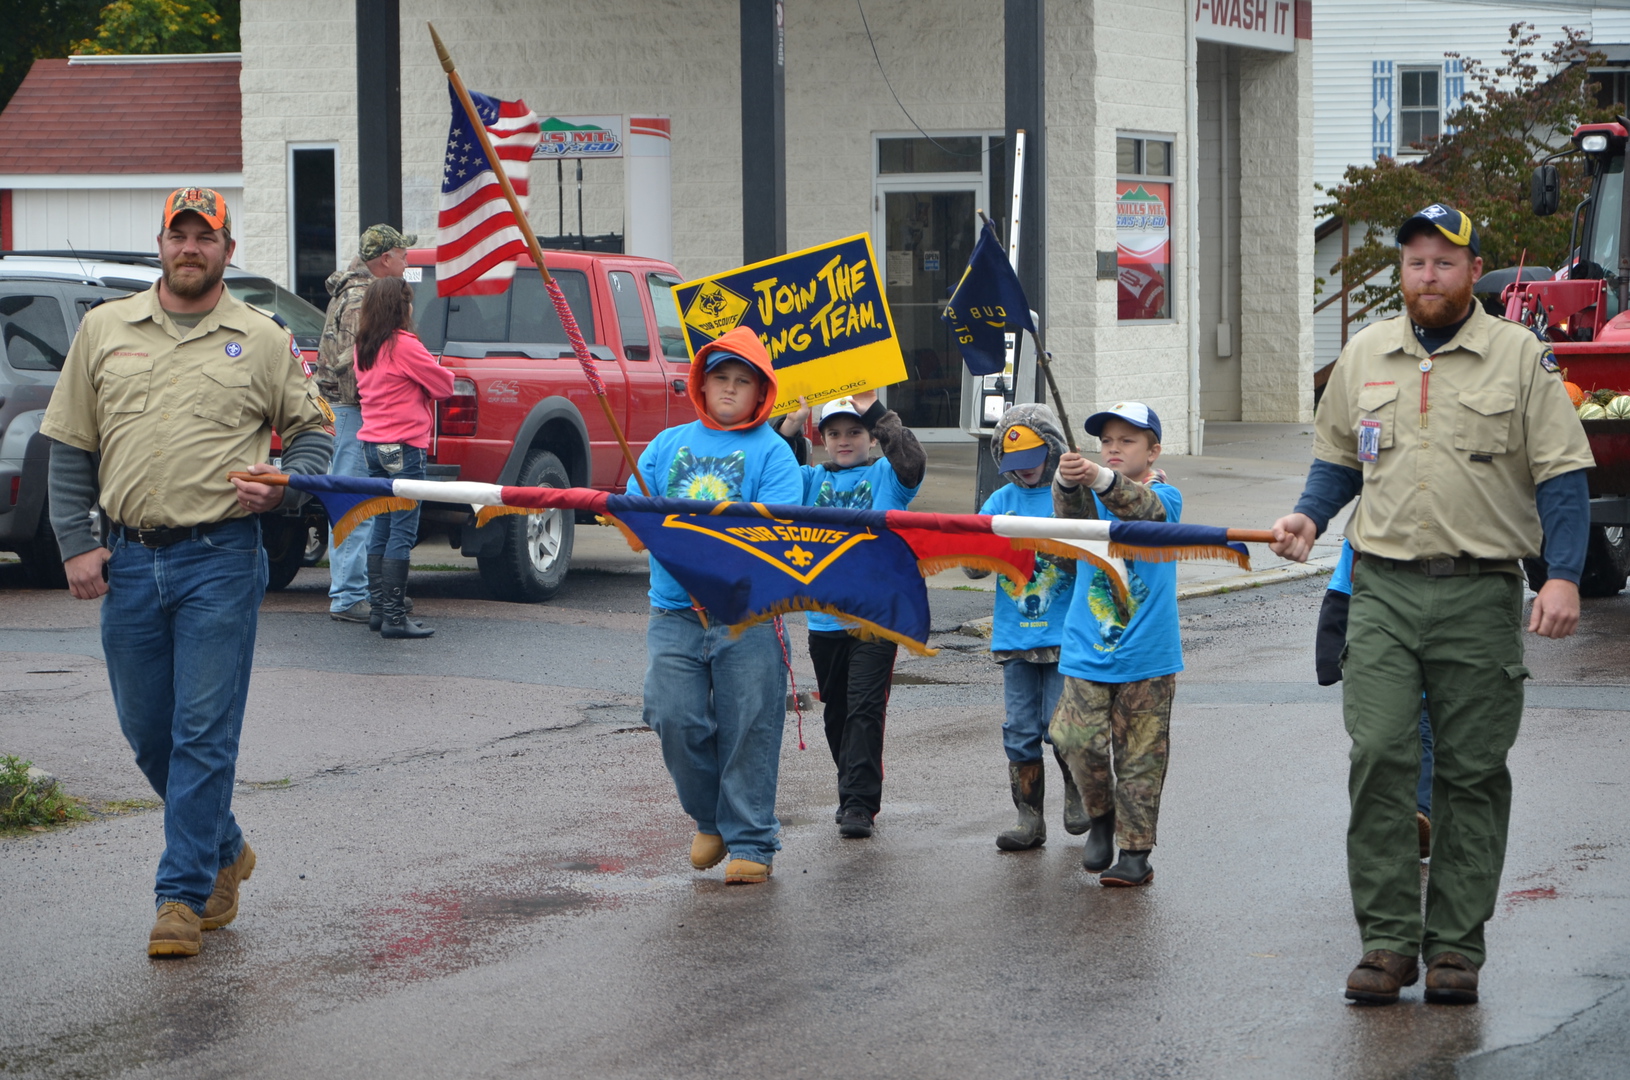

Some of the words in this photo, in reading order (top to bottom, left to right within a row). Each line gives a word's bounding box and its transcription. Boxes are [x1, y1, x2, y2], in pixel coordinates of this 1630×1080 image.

[1273, 1, 1290, 35] IT
[1117, 203, 1146, 215] WILLS
[816, 254, 867, 302] THE
[713, 314, 739, 328] SCOUTS
[809, 300, 883, 347] TEAM.
[725, 526, 779, 542] CUB
[772, 525, 850, 544] SCOUTS
